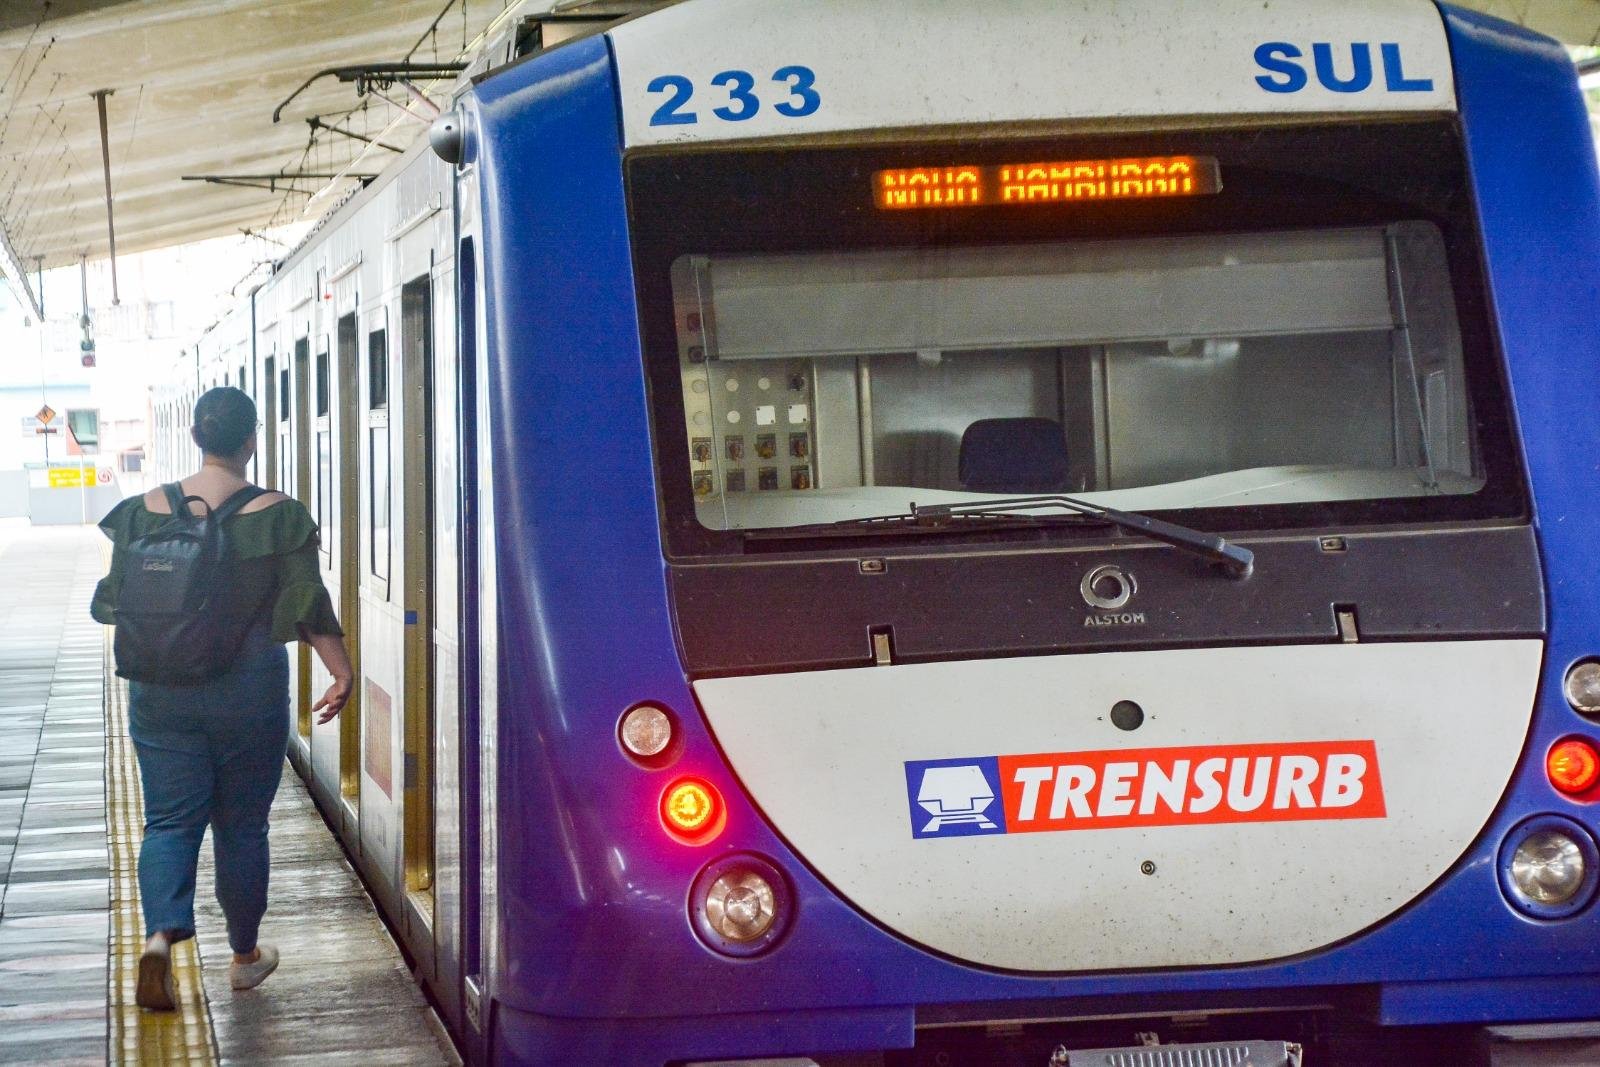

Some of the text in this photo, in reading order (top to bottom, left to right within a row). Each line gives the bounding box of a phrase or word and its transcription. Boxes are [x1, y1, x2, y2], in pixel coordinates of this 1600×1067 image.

[1254, 42, 1434, 93] SUL
[647, 65, 821, 127] 233
[1084, 612, 1145, 626] ALSTOM
[1013, 753, 1367, 822] TRENSURB
